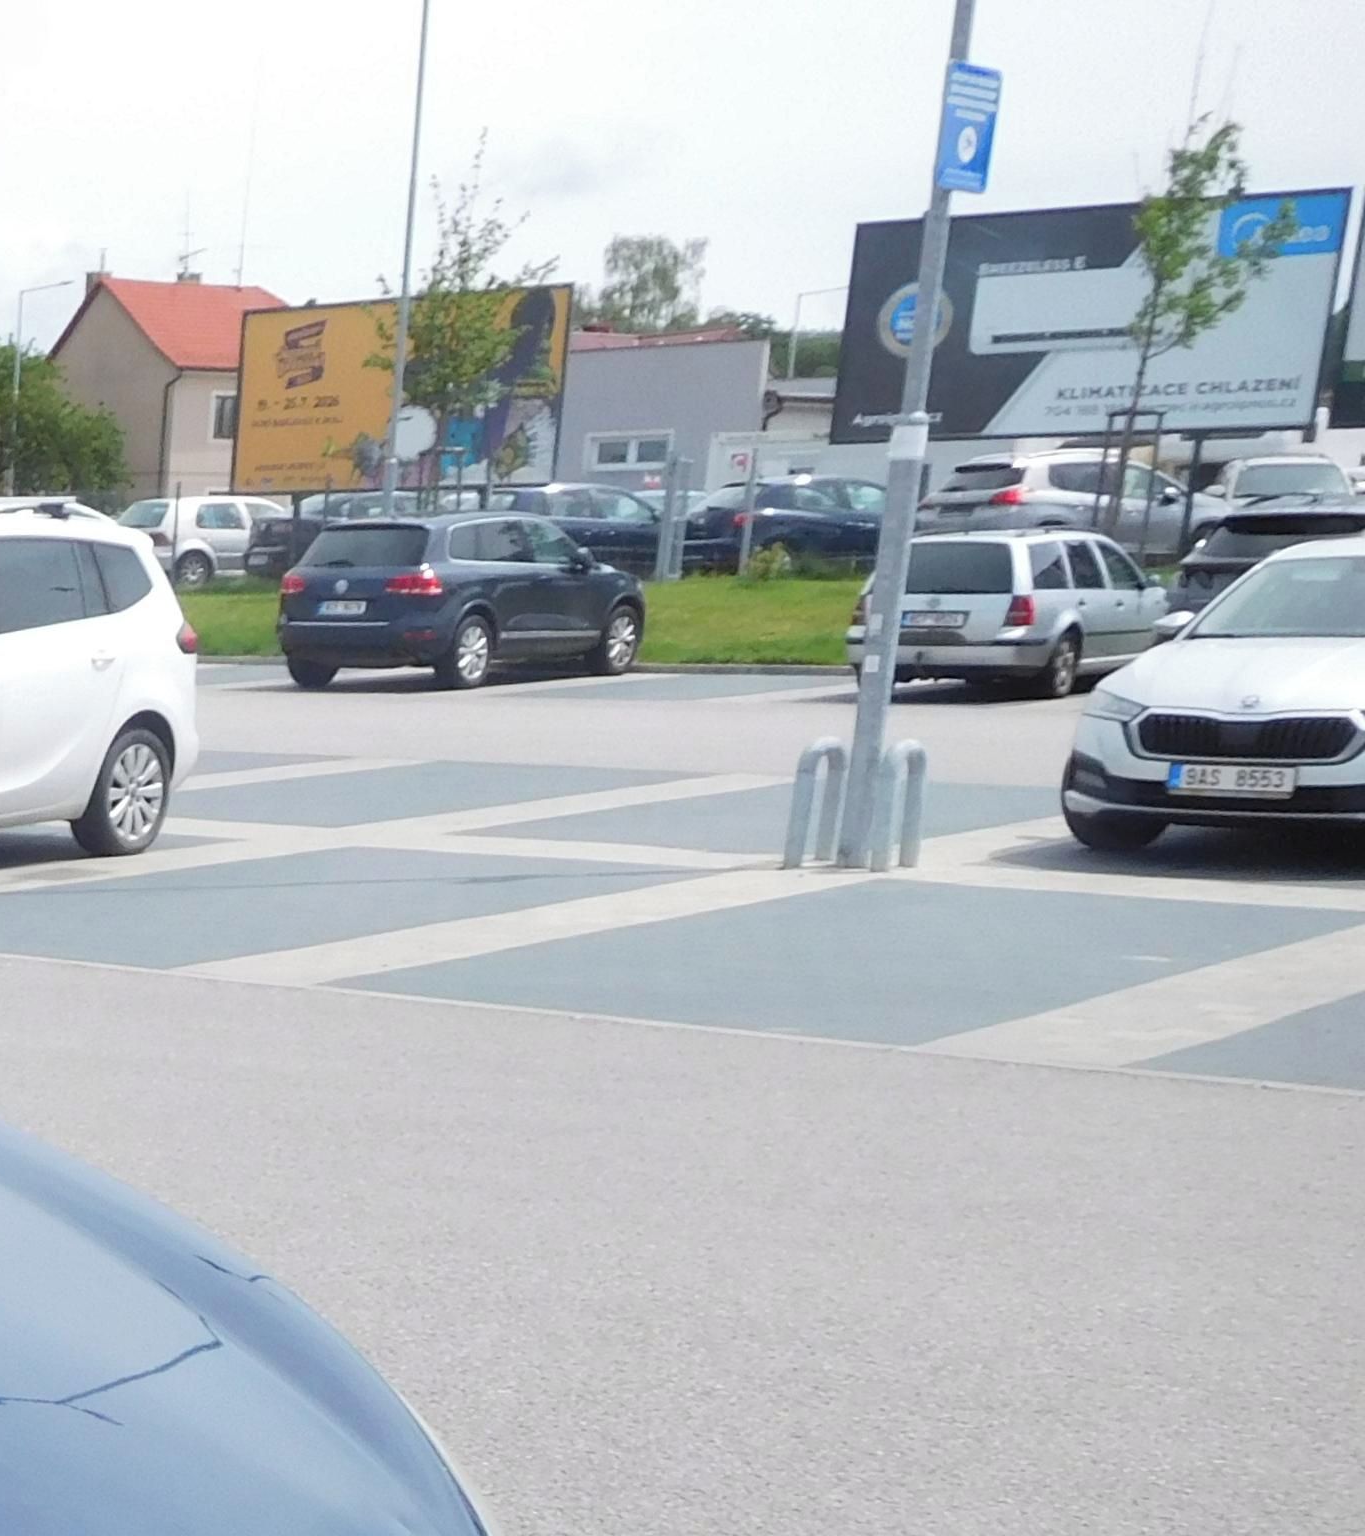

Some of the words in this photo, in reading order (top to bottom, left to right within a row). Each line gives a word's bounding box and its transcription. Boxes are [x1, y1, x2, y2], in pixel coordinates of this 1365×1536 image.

[1195, 374, 1303, 395] CHLAZENÍ
[1185, 766, 1221, 786] 9AS
[1235, 769, 1285, 788] 8553
